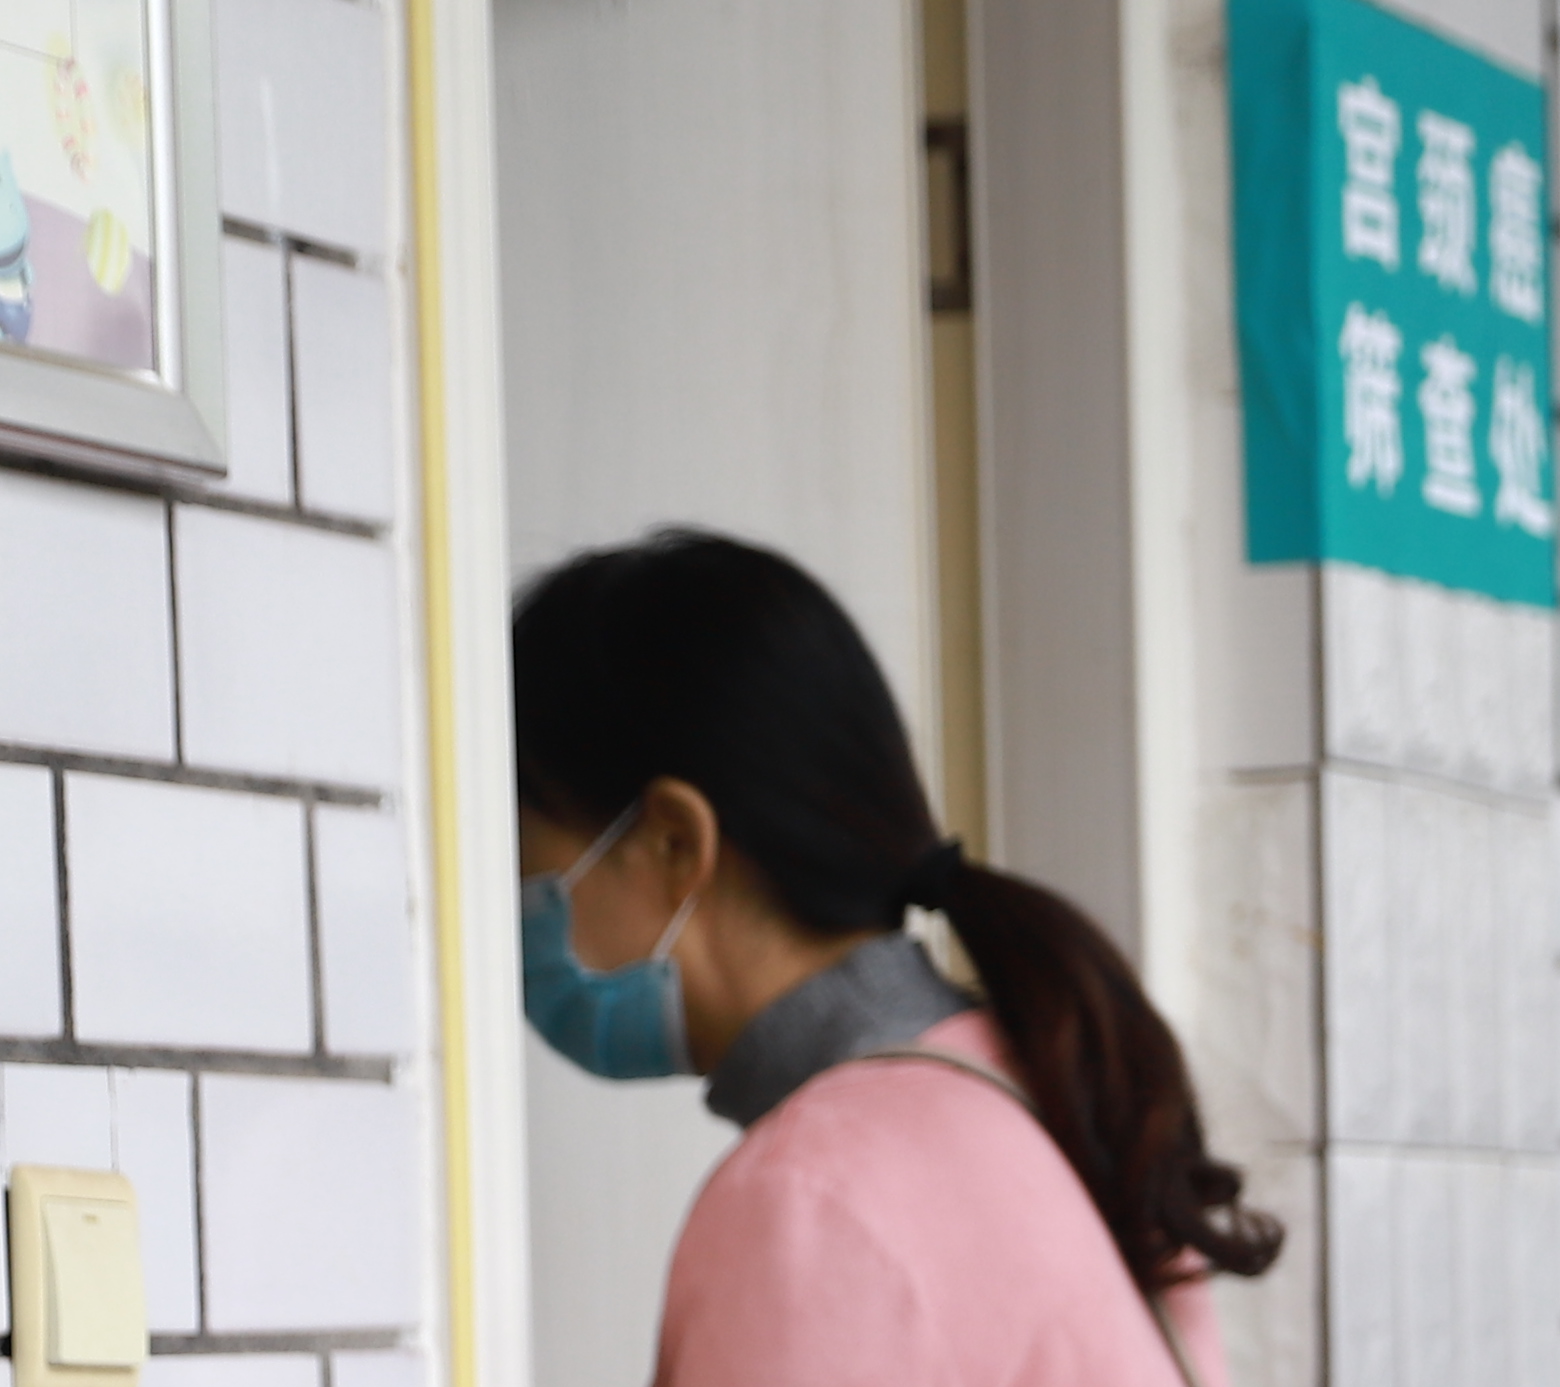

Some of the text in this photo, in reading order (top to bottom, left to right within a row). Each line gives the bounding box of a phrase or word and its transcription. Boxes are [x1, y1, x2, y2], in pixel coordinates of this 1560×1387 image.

[1337, 77, 1543, 323] 宫颈癌
[1338, 301, 1554, 538] 筛查处
